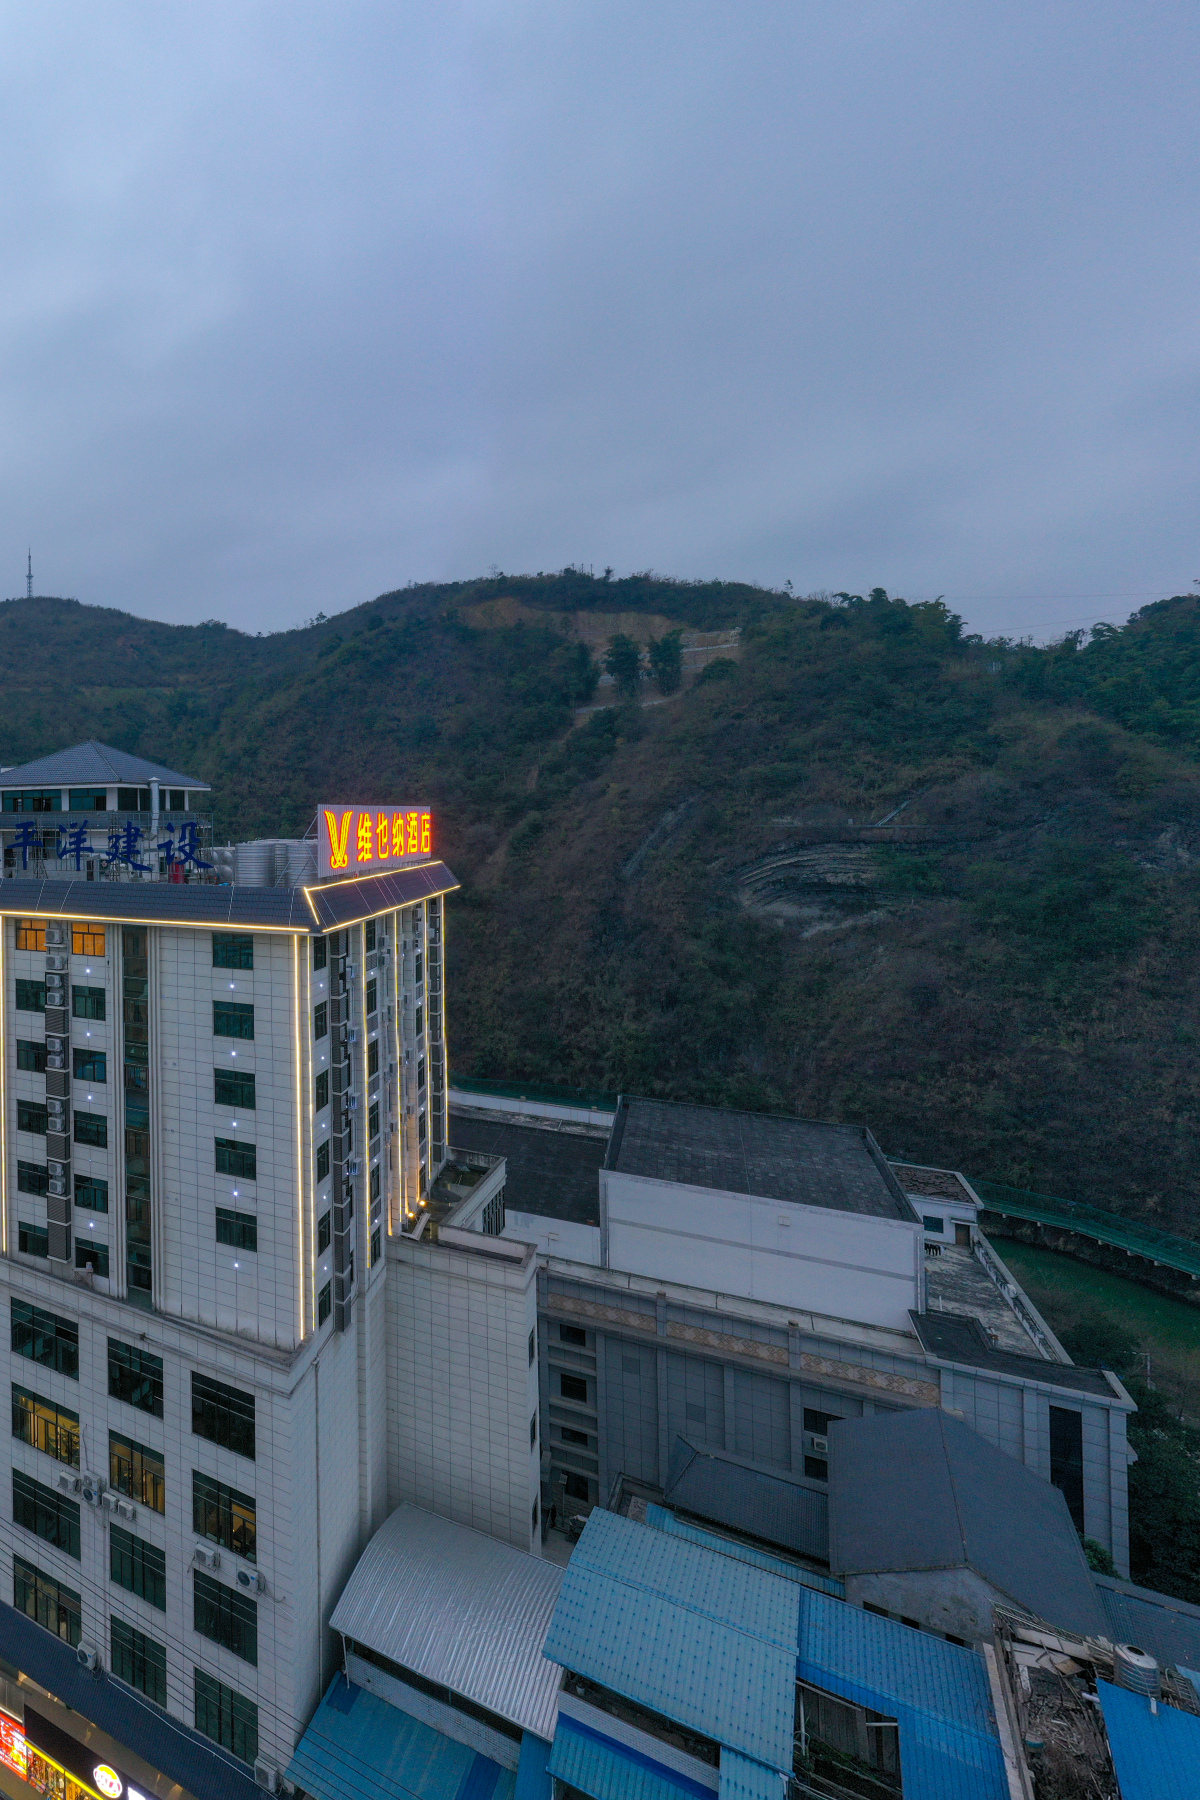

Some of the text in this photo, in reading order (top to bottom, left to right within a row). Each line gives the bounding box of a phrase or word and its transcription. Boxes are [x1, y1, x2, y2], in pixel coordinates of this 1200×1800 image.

[357, 812, 431, 862] 维也纳酒店
